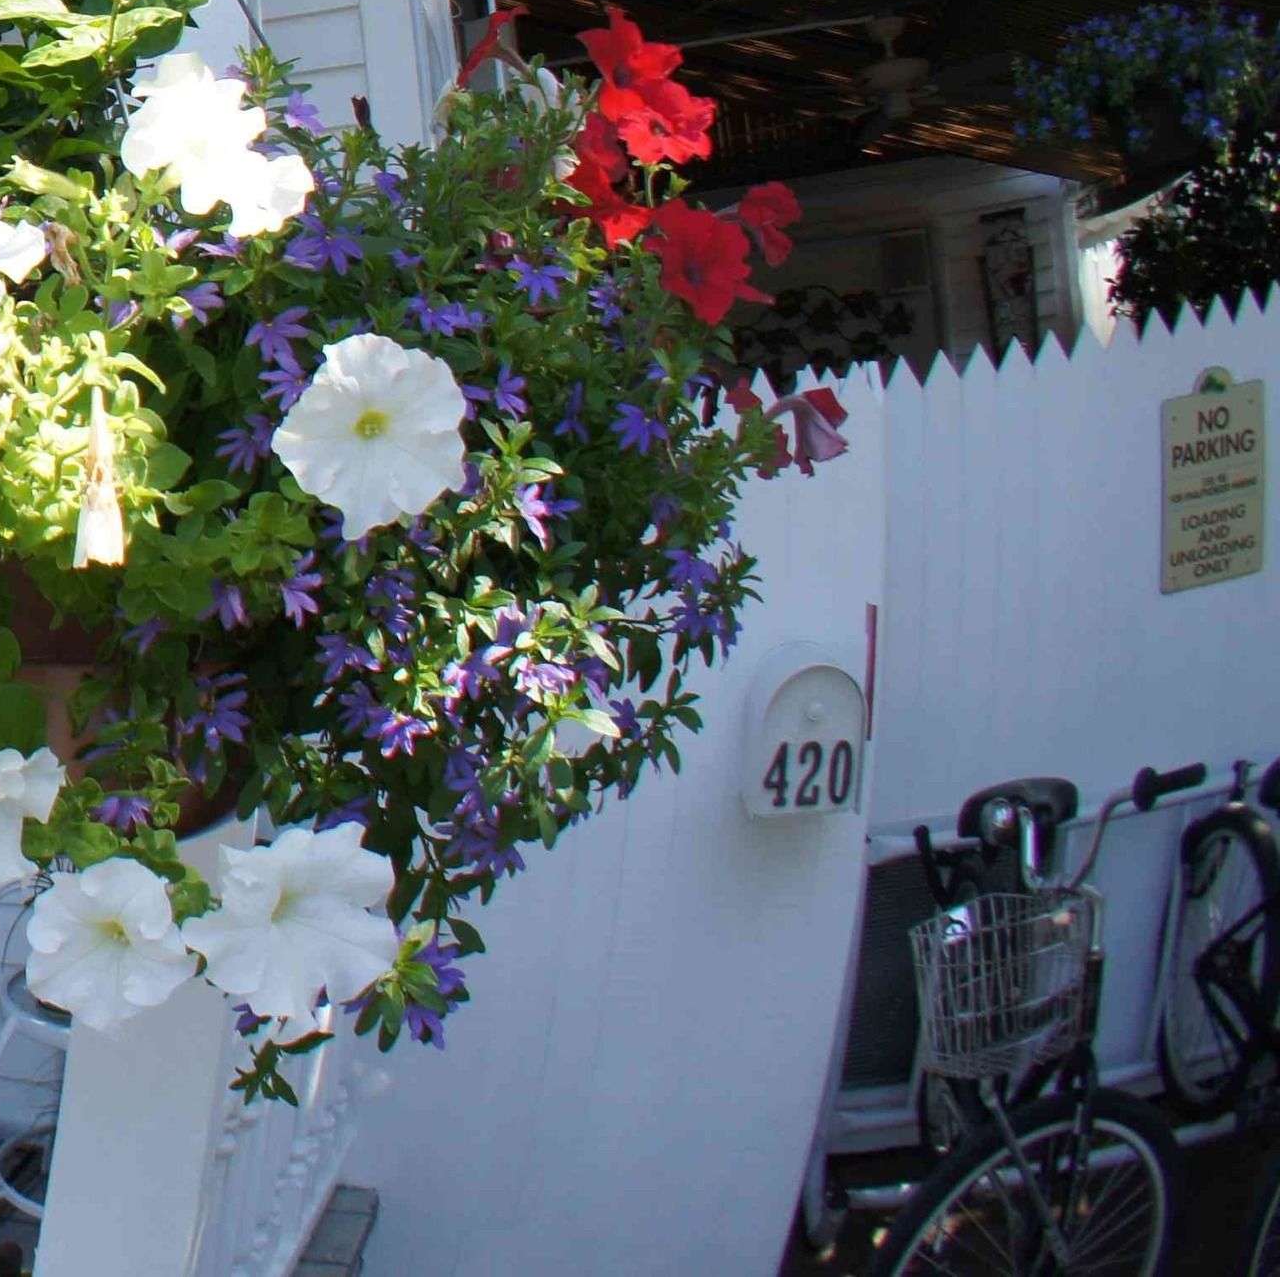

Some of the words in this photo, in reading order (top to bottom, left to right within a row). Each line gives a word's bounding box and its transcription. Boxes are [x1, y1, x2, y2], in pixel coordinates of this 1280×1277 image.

[1197, 405, 1230, 435] NO
[1171, 428, 1256, 469] PARKING
[1181, 503, 1247, 532] LOADING
[1198, 524, 1231, 544] AND
[1169, 534, 1256, 567] UNLOADING
[1193, 557, 1233, 579] ONLY
[762, 739, 853, 808] 420
